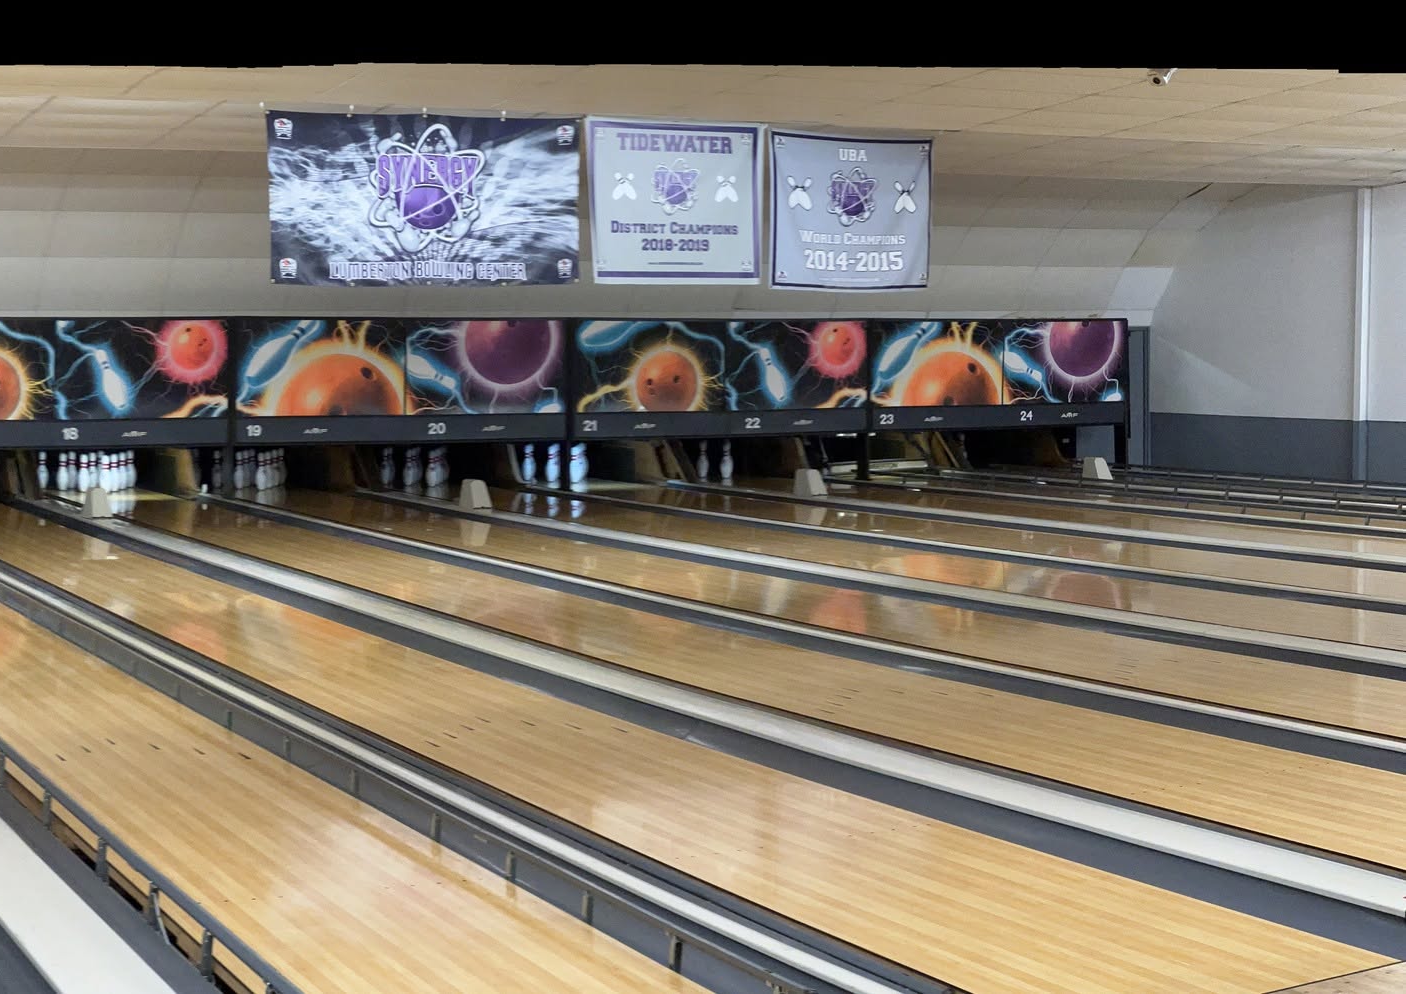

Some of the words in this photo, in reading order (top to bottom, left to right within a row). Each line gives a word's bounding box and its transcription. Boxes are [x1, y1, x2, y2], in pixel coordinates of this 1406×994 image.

[616, 132, 733, 154] TIDEWATER
[838, 148, 867, 162] UBA
[610, 220, 666, 234] DISTRICT
[669, 221, 739, 235] CHAMPIONS
[798, 229, 841, 244] WORLD
[843, 232, 906, 246] CHAMPIONS
[641, 238, 710, 252] 2018-2019
[804, 248, 904, 272] 2014-2015
[329, 261, 412, 281] LUMBERTON
[413, 260, 475, 281] BOWLING
[475, 262, 527, 281] CENTER
[879, 413, 895, 425] 23
[1020, 410, 1033, 422] 24
[427, 422, 447, 435] 20
[582, 419, 598, 432] 21
[744, 417, 761, 429] 22
[61, 427, 79, 440] 18
[246, 424, 262, 437] 19
